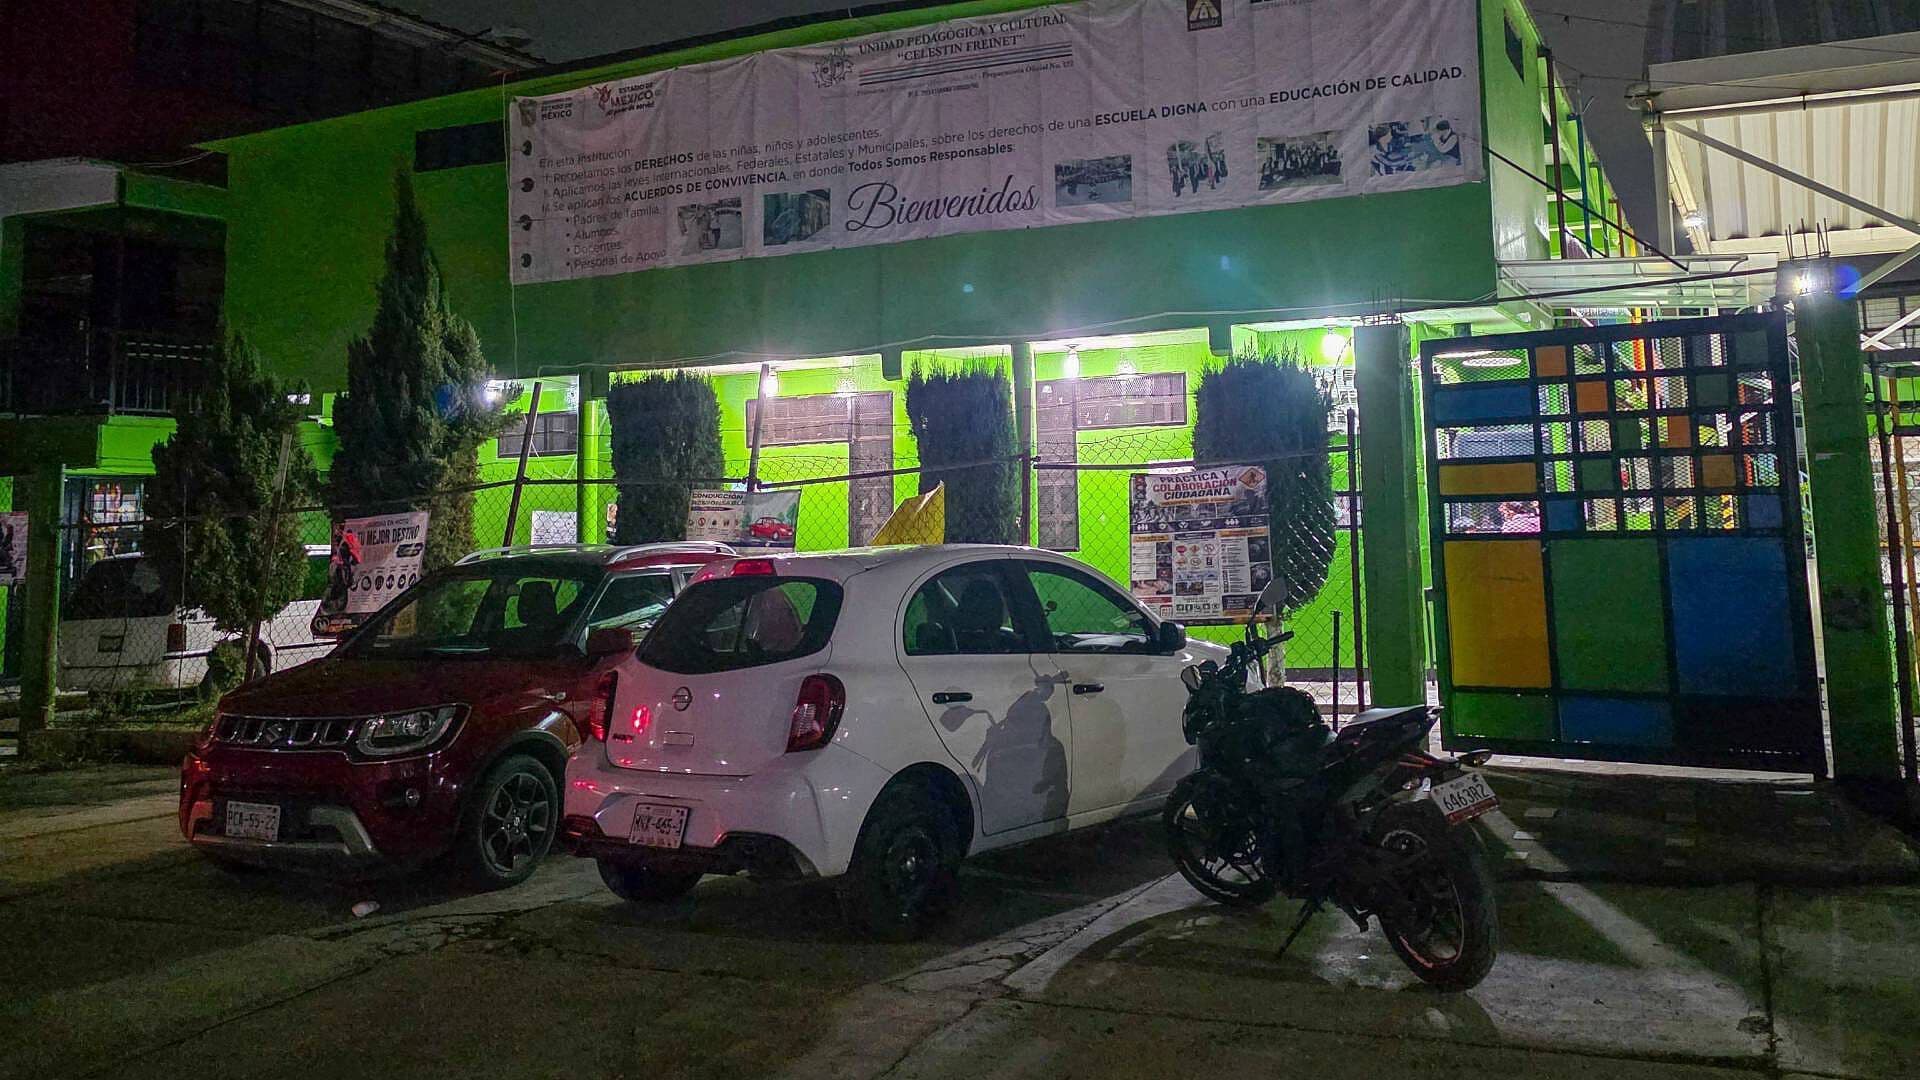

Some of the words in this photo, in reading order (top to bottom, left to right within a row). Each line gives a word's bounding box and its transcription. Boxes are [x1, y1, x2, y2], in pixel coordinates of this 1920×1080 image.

[860, 39, 904, 54] UNIDAD
[988, 23, 997, 34] Y
[848, 149, 855, 160] y
[931, 132, 965, 145] sobre
[968, 129, 985, 141] los
[989, 123, 1044, 138] derechos
[1048, 120, 1063, 131] de
[1068, 118, 1091, 129] una
[1095, 108, 1157, 125] ESCUELA
[1161, 102, 1207, 118] DIGNA
[1211, 98, 1236, 112] con
[1240, 95, 1266, 109] una
[1270, 80, 1361, 103] EDUCACIÓN
[1365, 76, 1387, 91] DE
[634, 152, 694, 171] DERECHOS
[697, 151, 709, 161] de
[712, 150, 727, 159] las
[797, 139, 803, 149] y
[624, 184, 683, 202] ACUERDOS
[687, 181, 702, 193] DE
[793, 170, 806, 180] en
[809, 165, 845, 178] donde
[848, 160, 882, 172] Todos
[886, 154, 927, 168] Somos
[846, 175, 1040, 232] Bienvenidos
[621, 254, 633, 264] de
[1222, 470, 1229, 479] Y
[1164, 487, 1231, 500] CIUDADANA
[367, 529, 391, 545] MEJOR
